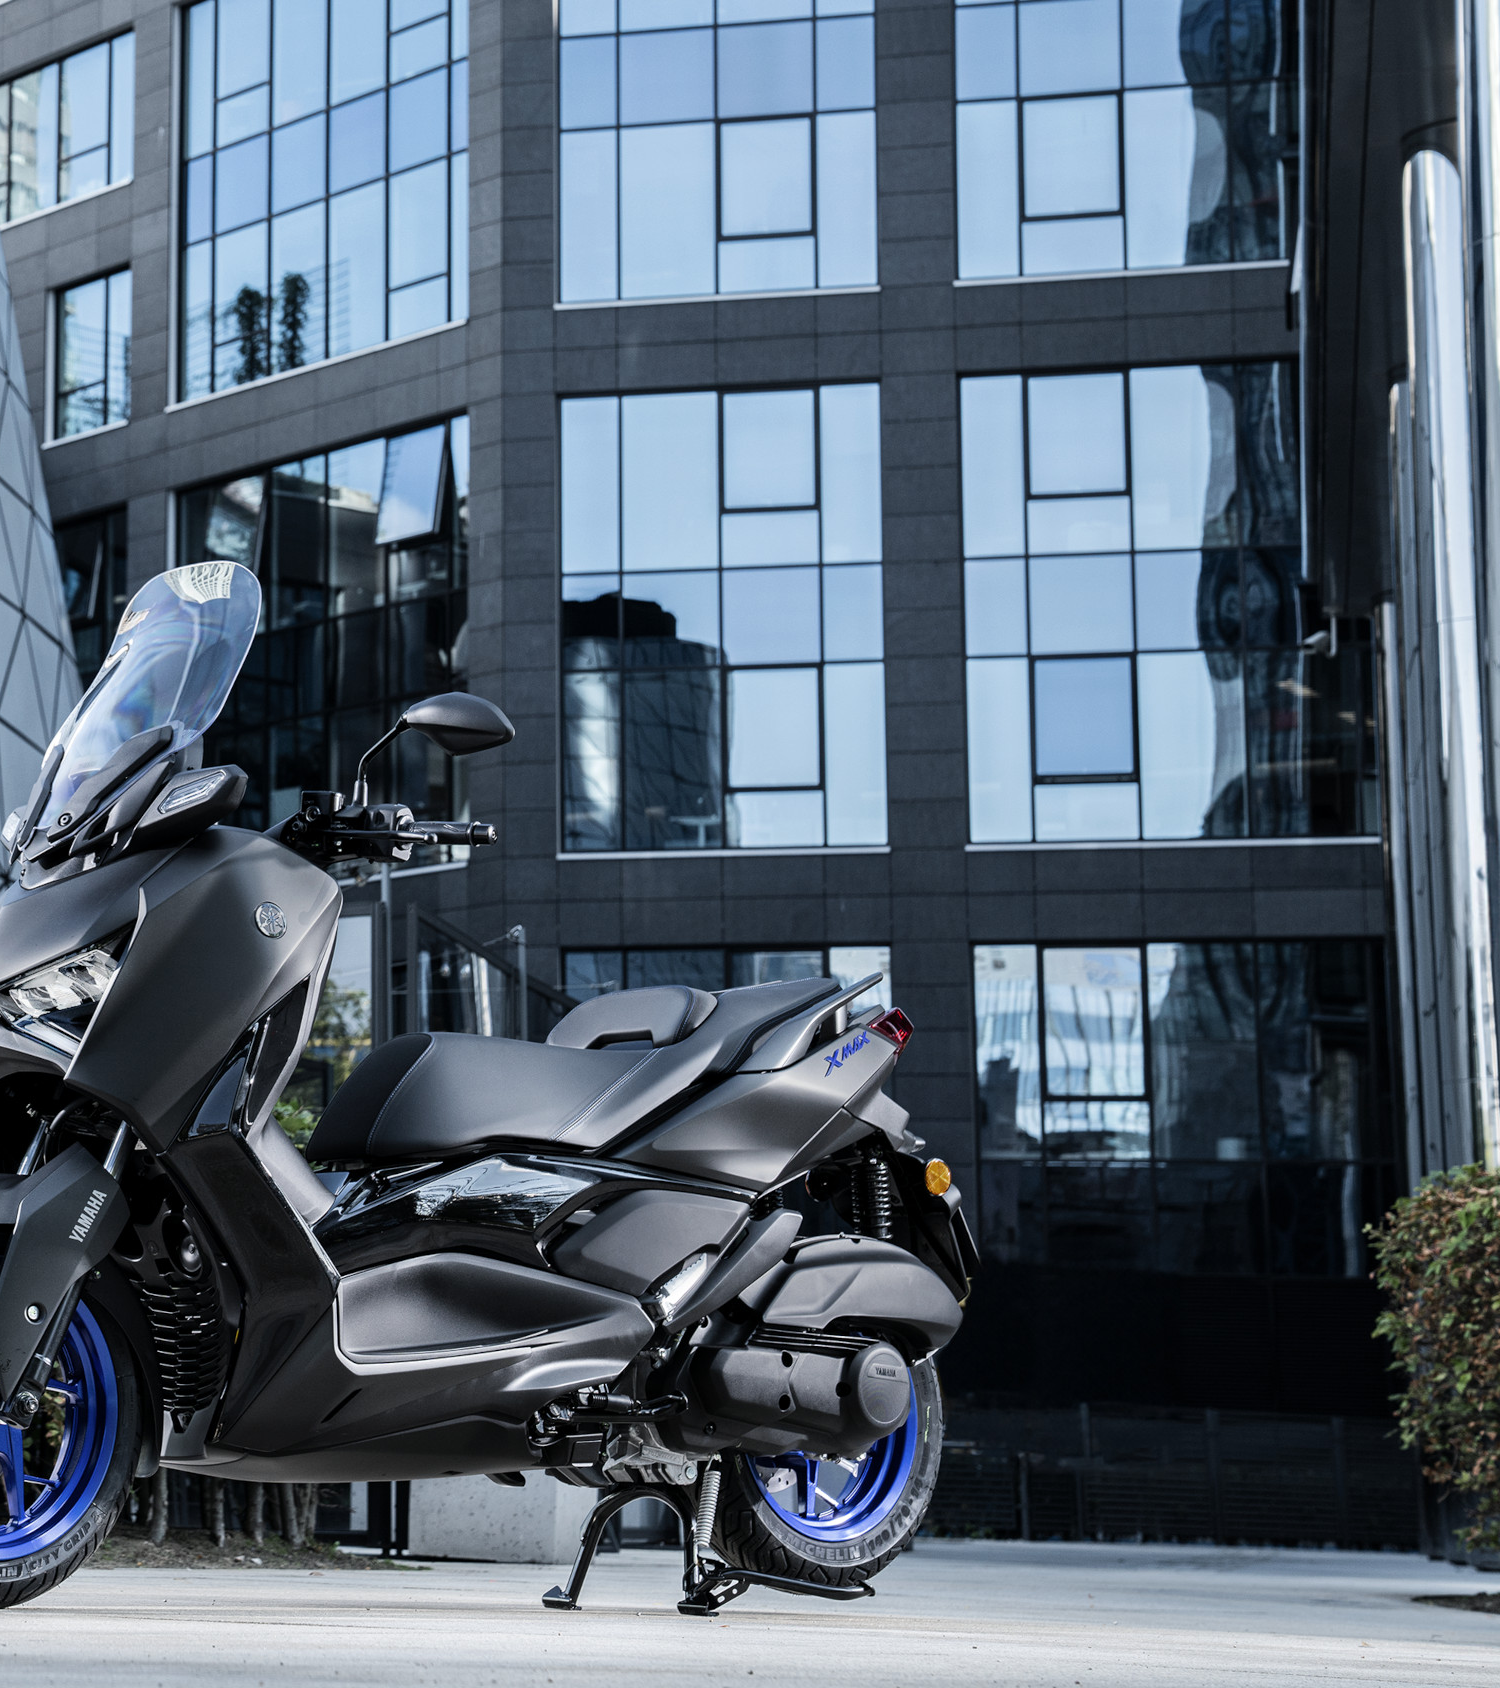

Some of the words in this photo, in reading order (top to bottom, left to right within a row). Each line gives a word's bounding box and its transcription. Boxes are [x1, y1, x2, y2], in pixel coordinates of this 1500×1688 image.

[68, 1190, 107, 1243] YAMAHA
[875, 1366, 897, 1377] YAMAHA
[28, 1548, 61, 1572] CITY
[63, 1521, 92, 1552] GRIP
[786, 1532, 861, 1560] MICHELIN
